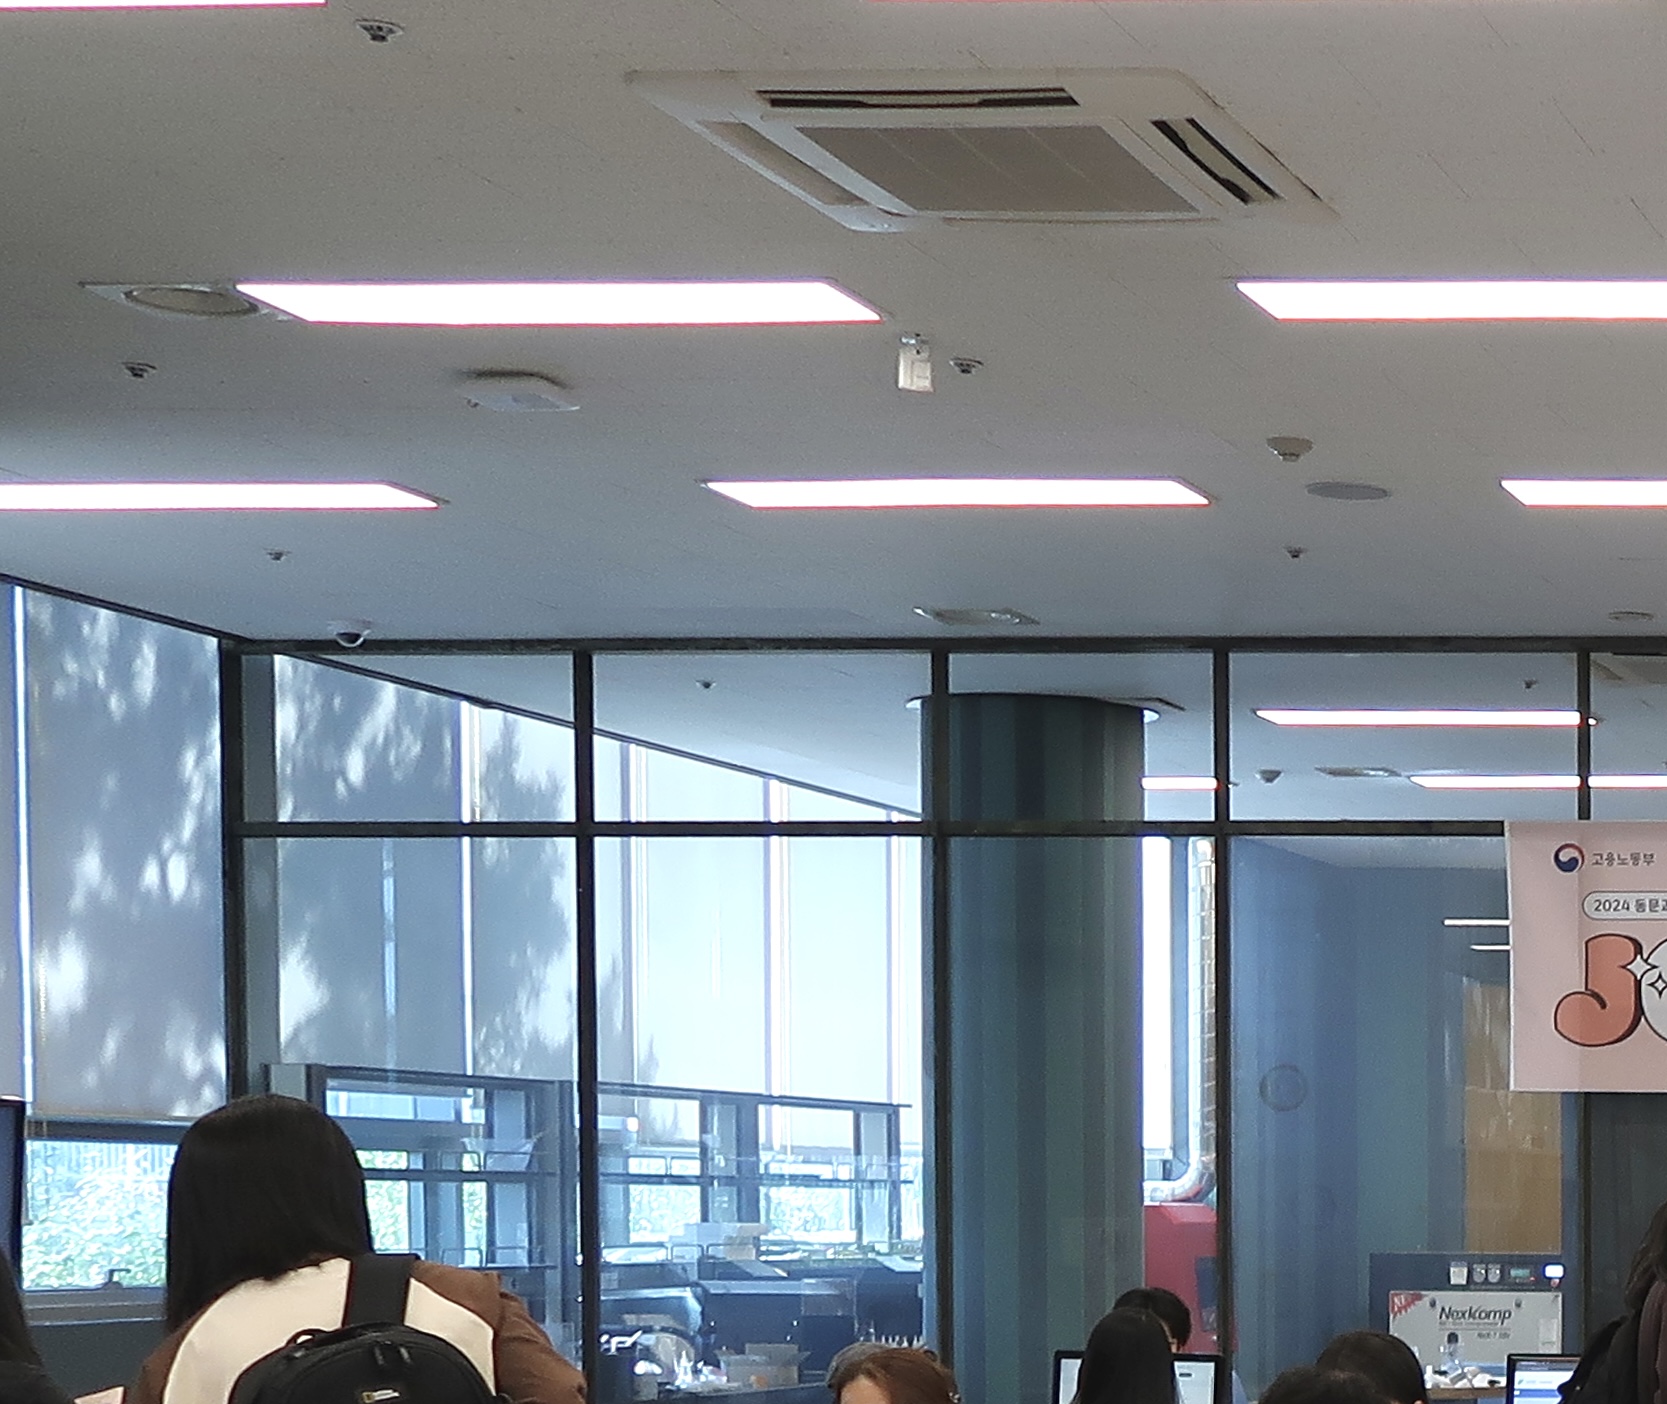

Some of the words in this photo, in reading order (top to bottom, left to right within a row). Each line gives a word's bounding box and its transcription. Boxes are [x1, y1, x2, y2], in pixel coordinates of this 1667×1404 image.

[1592, 852, 1655, 867] 고용노동부
[1593, 898, 1630, 913] 2024
[1438, 1304, 1512, 1326] NexKomp
